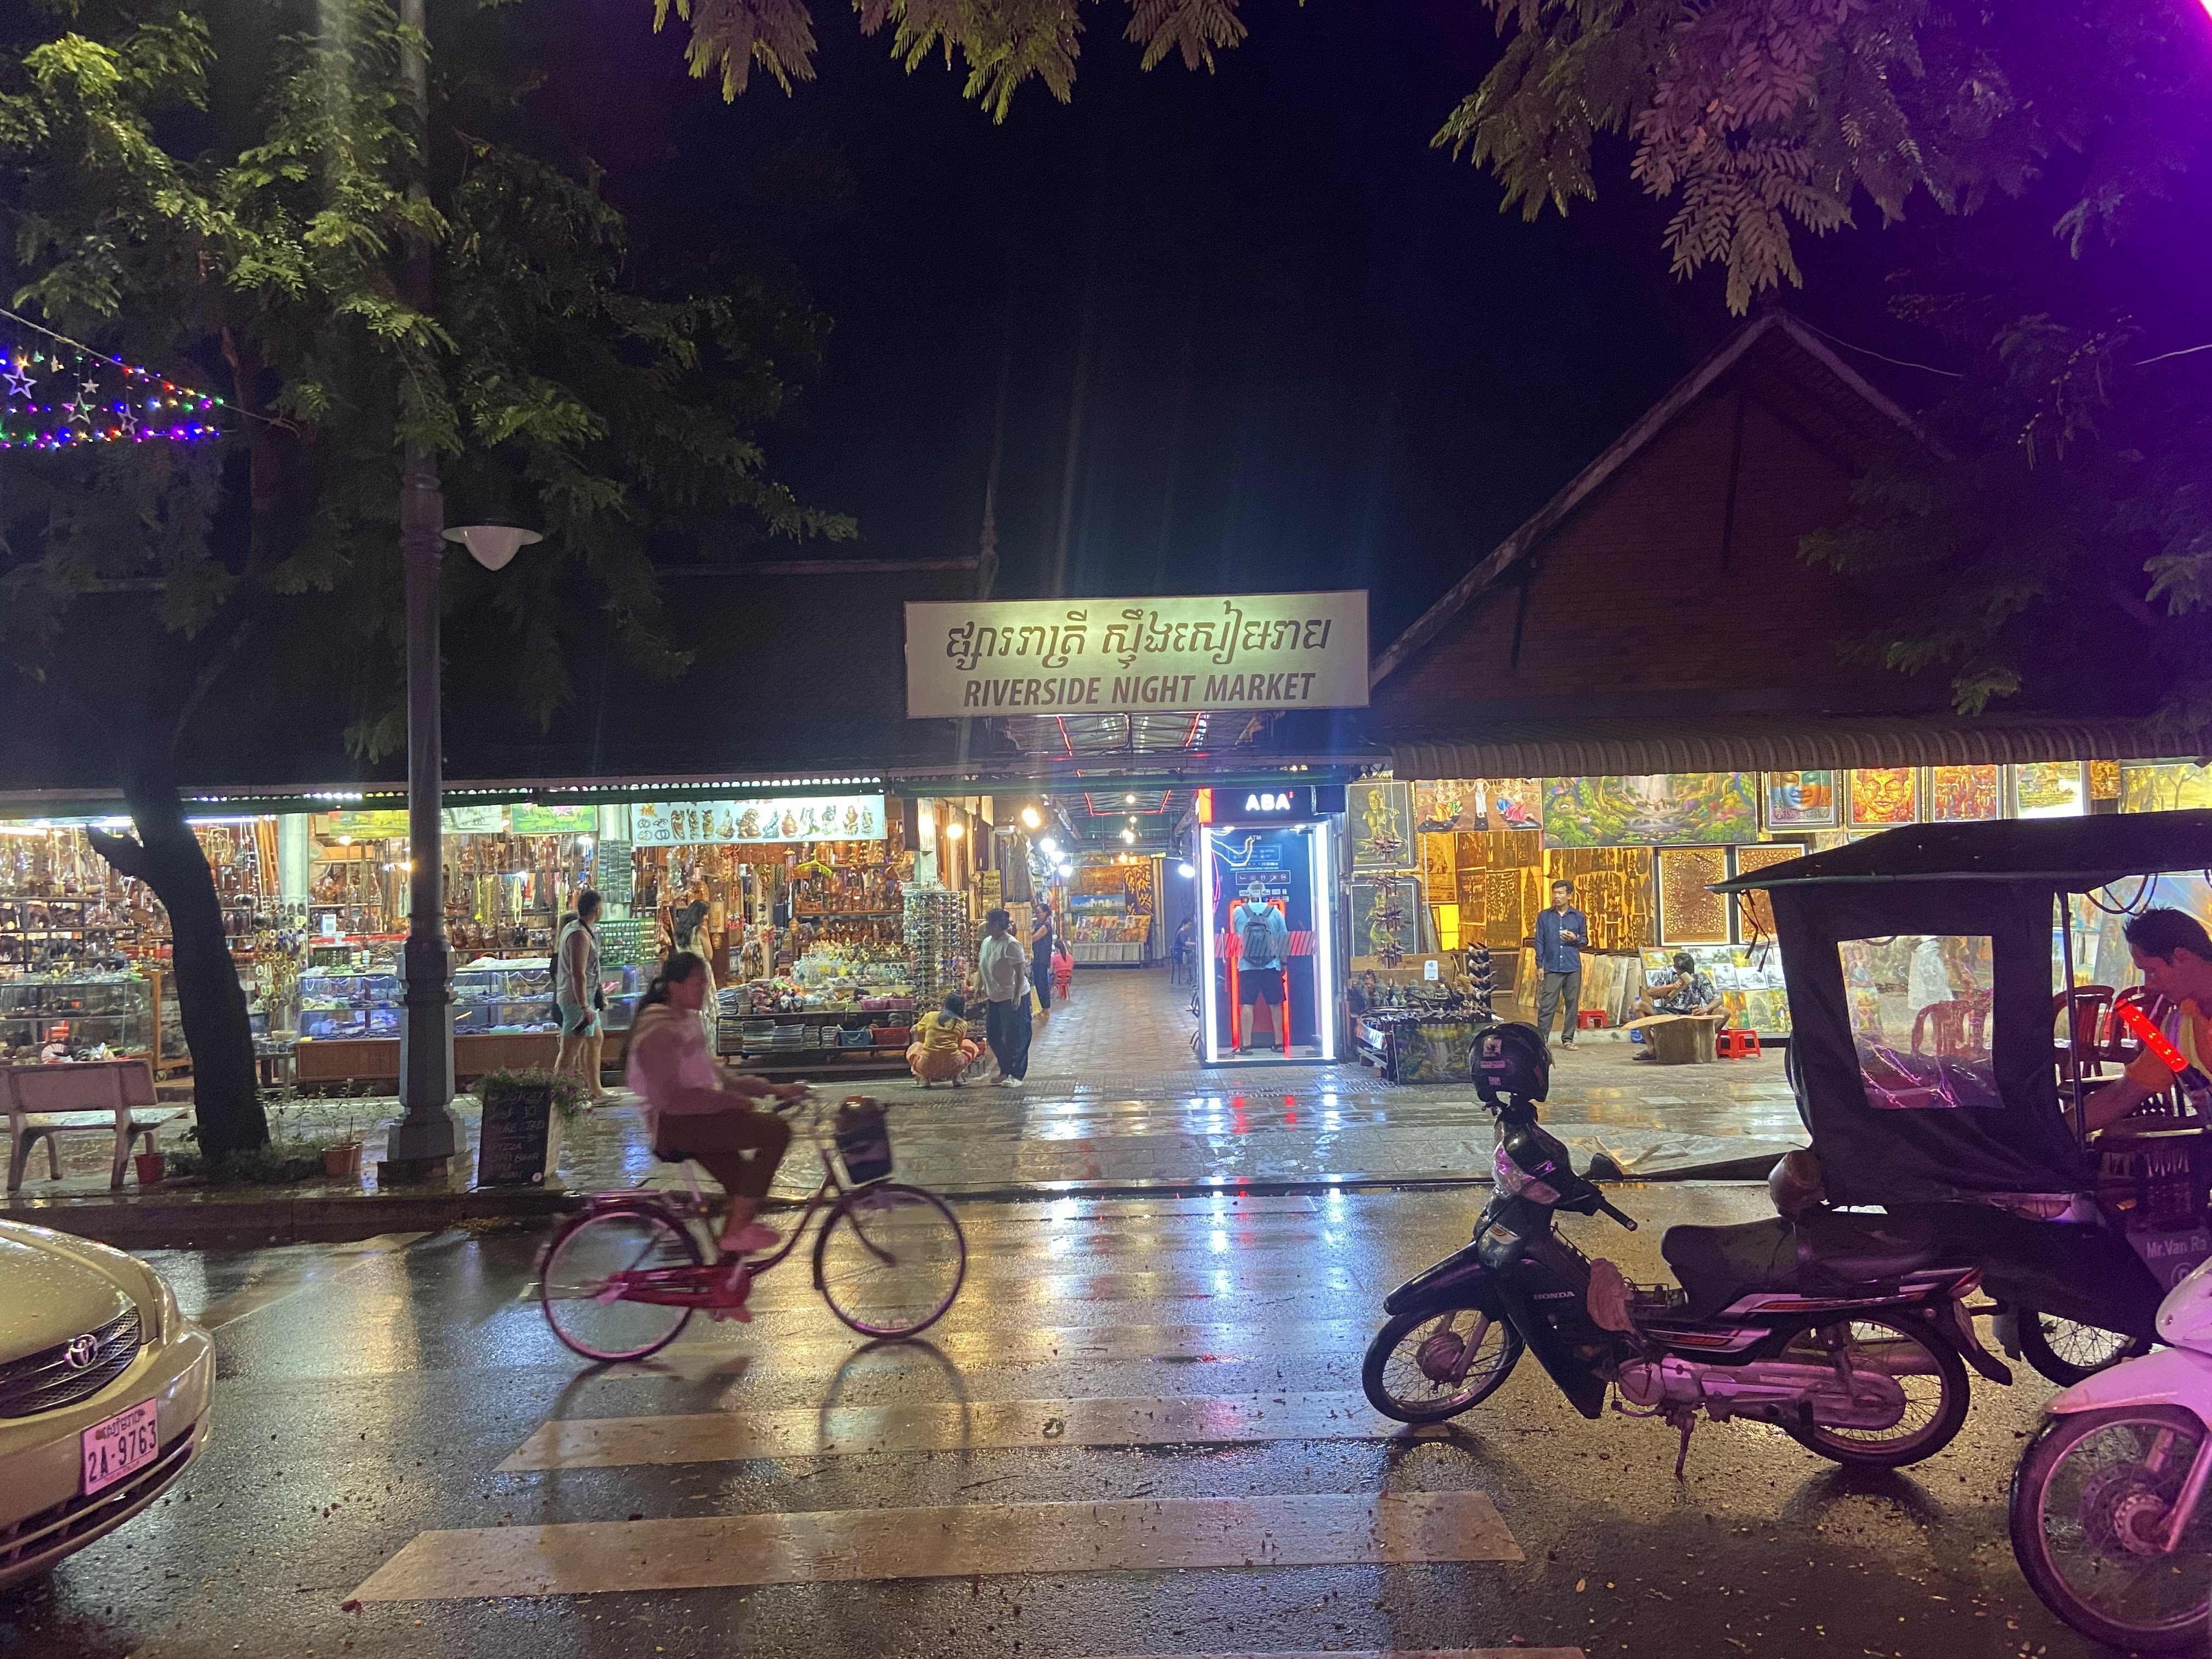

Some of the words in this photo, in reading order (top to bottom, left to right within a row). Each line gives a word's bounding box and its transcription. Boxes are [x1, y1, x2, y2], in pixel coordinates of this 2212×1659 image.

[964, 676, 1101, 708] RIVERSIDE
[1111, 675, 1197, 704] NIGHT
[1204, 672, 1316, 703] MARKET
[1245, 793, 1290, 811] ABA
[1533, 1291, 1576, 1300] HONDA
